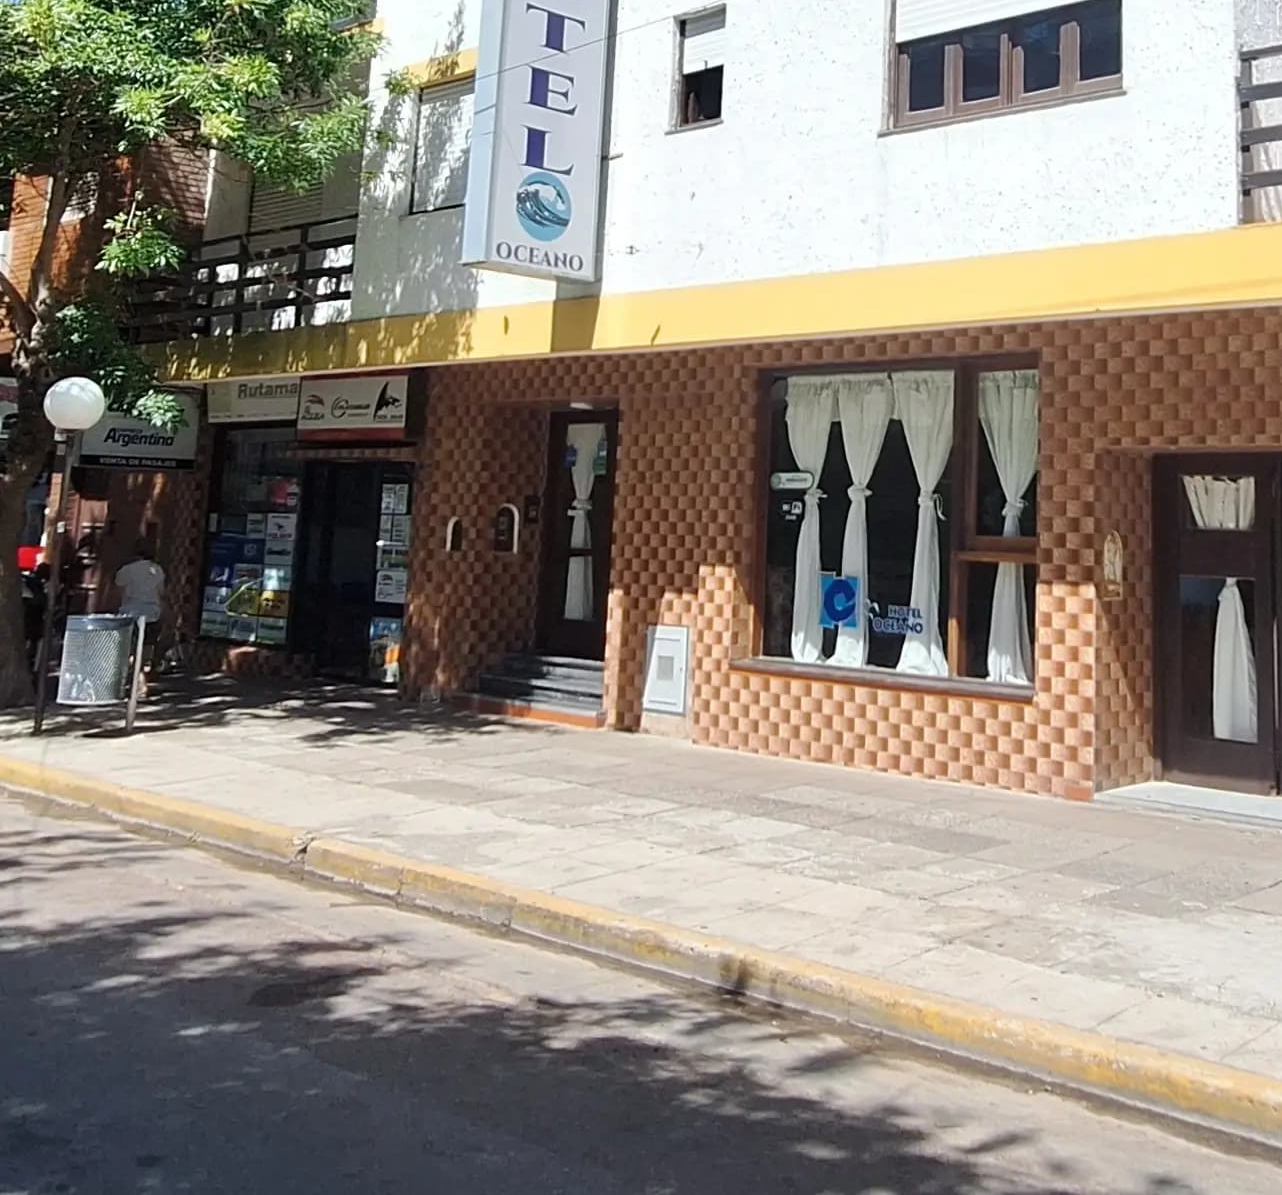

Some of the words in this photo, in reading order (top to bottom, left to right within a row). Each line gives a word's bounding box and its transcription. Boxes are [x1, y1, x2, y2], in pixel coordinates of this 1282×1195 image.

[495, 241, 584, 273] OCEANO
[103, 427, 176, 447] Argentina
[888, 605, 922, 618] HOTEL
[872, 617, 924, 634] OCEANO
